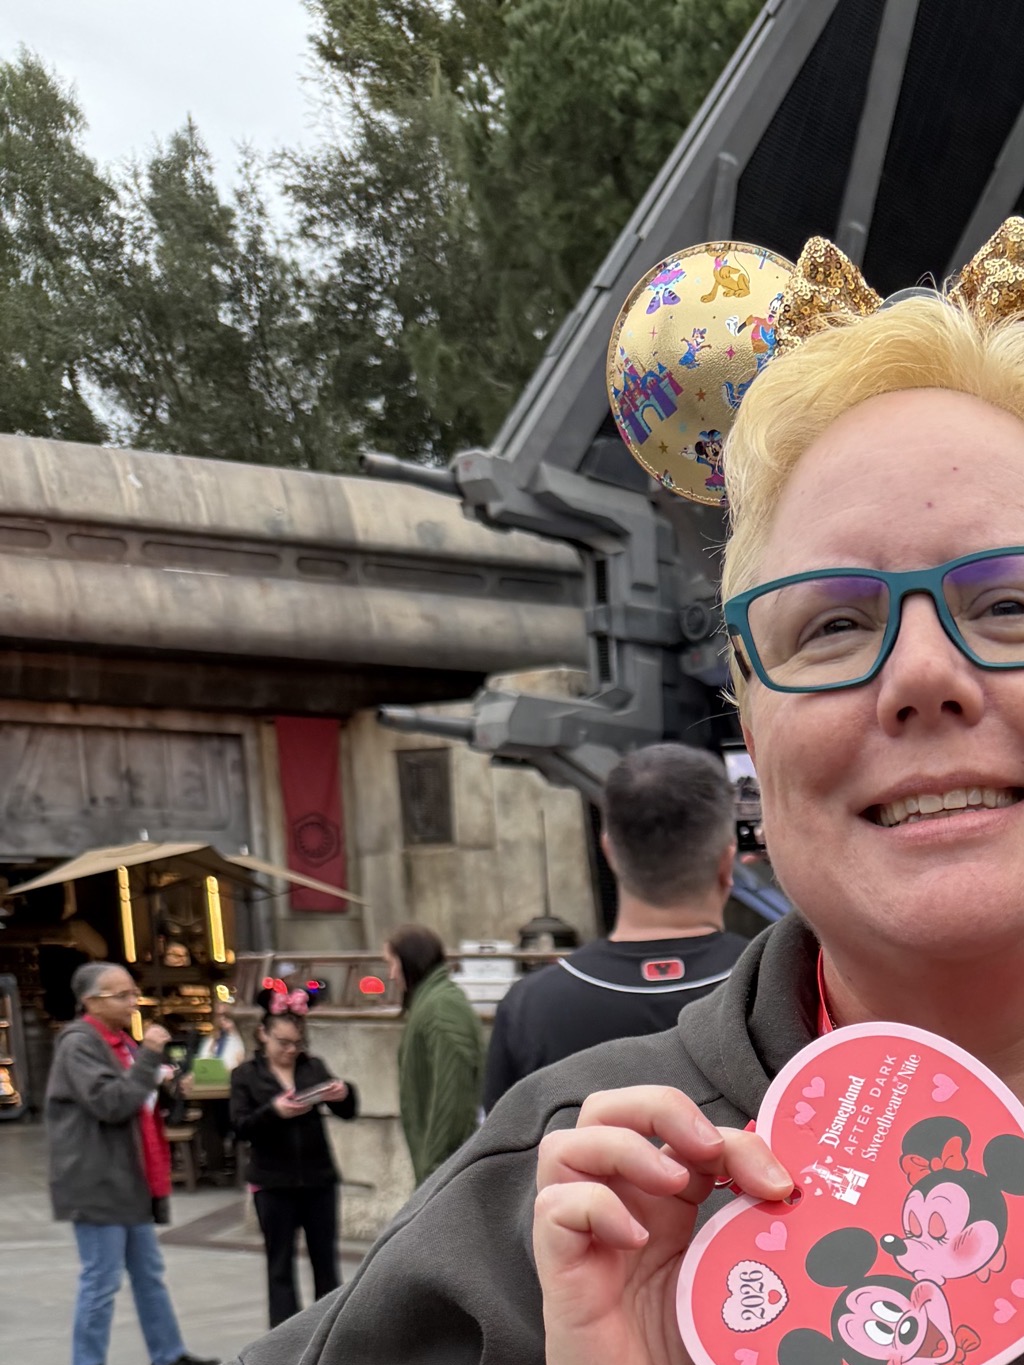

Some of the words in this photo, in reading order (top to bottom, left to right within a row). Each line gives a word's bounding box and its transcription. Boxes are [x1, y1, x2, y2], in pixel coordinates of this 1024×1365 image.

[896, 1054, 921, 1080] Nite
[817, 1075, 867, 1149] Disneyland
[844, 1104, 875, 1156] AFTER
[869, 1054, 897, 1098] DARK
[741, 1269, 765, 1321] 2026
